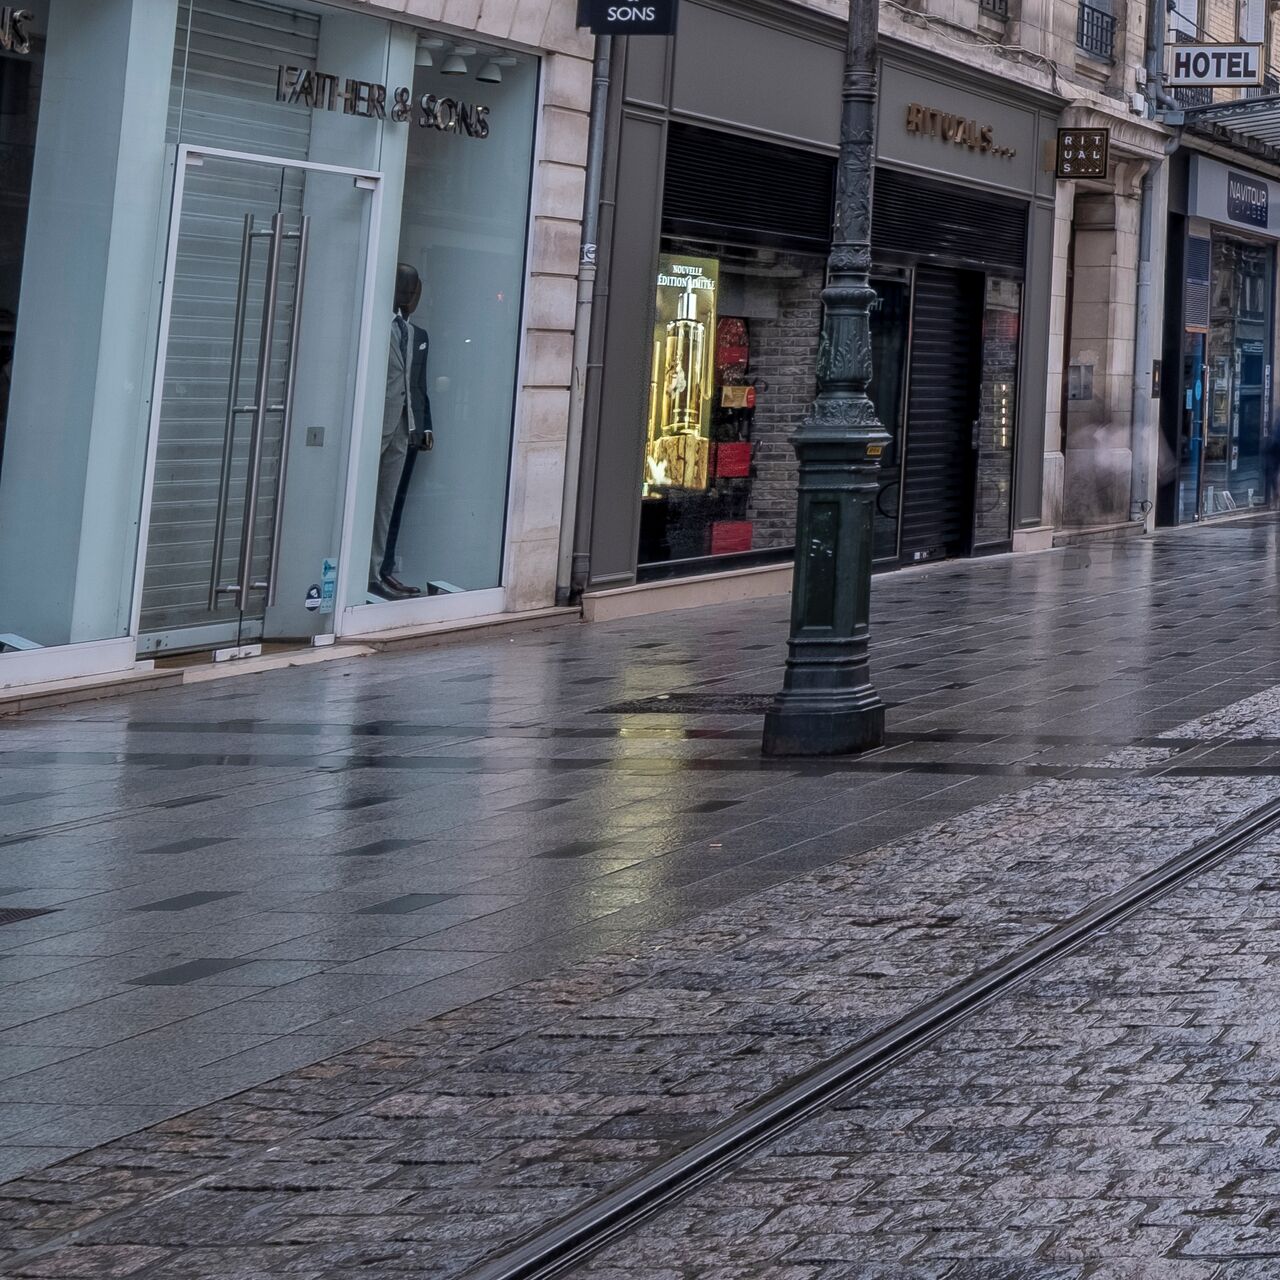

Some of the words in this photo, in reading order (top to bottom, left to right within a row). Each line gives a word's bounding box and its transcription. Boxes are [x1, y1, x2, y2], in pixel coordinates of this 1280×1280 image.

[607, 6, 656, 21] SONS
[1174, 52, 1257, 78] HOTEL
[275, 64, 387, 120] FATHER
[391, 86, 412, 122] &
[419, 93, 490, 139] SONS
[1229, 180, 1267, 208] NAVITOUR
[671, 264, 704, 276] NOUVELLE
[656, 273, 687, 288] ÉDITION
